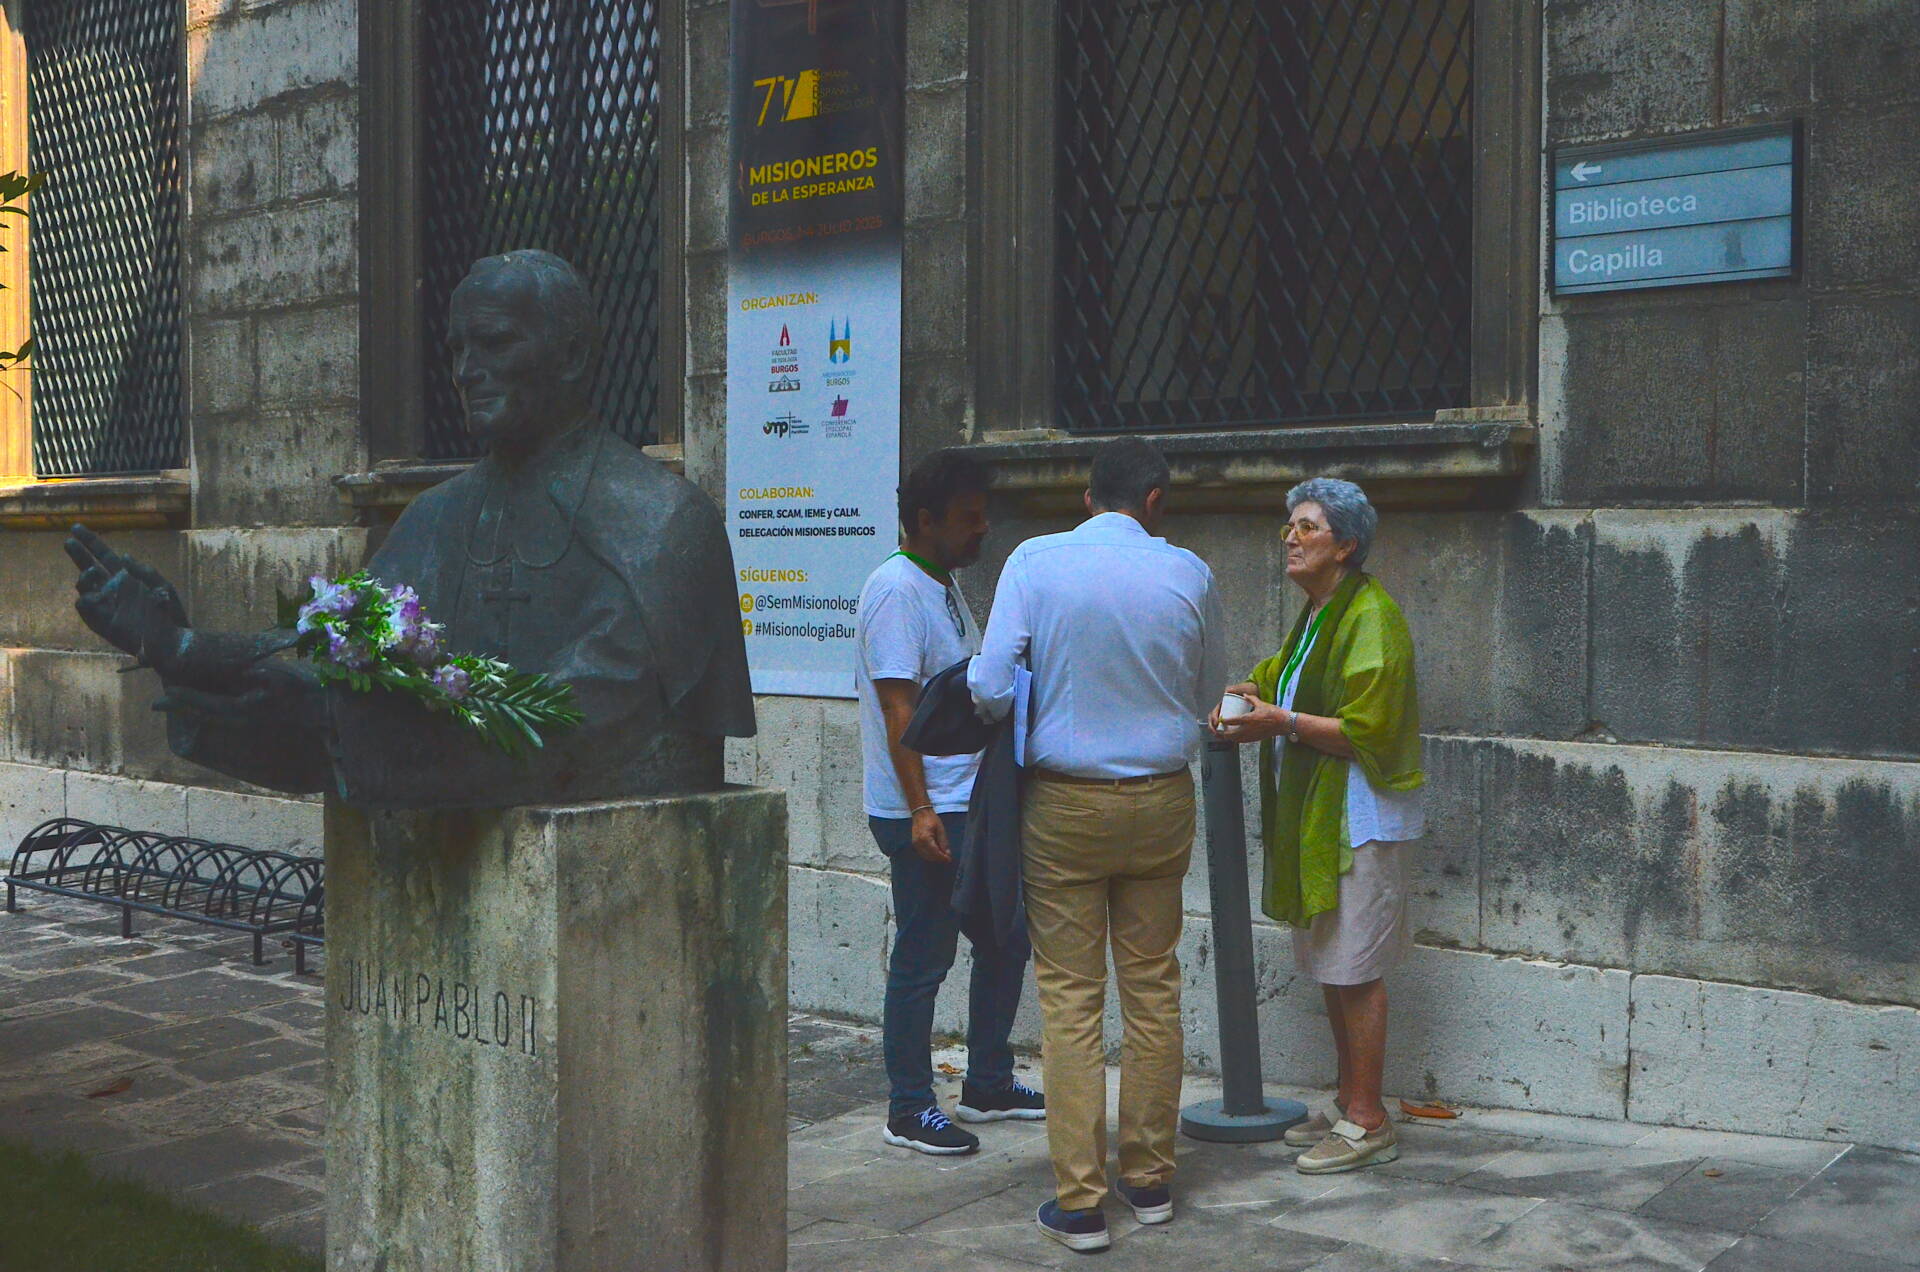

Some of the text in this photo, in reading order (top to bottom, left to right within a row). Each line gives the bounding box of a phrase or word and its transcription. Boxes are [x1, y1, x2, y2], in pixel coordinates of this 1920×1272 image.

[749, 147, 878, 186] MISIONEROS
[752, 176, 875, 206] DE LA ESPERANZA
[1569, 194, 1697, 224] Biblioteca
[1569, 244, 1662, 276] Capilla
[741, 293, 819, 311] ORGANIZAN:
[771, 364, 798, 373] BURGOS
[826, 378, 850, 386] BURGOS
[739, 487, 814, 499] COLABORAN:
[739, 510, 774, 519] CONFER,
[804, 508, 825, 518] IEME
[827, 510, 832, 519] y
[834, 508, 860, 517] CALM.
[740, 526, 875, 537] DELEGACIÓN MISIONES BURGOS
[740, 566, 808, 582] SÍGUENOS:
[340, 960, 407, 1024] JUAN
[416, 972, 510, 1047] PABLO
